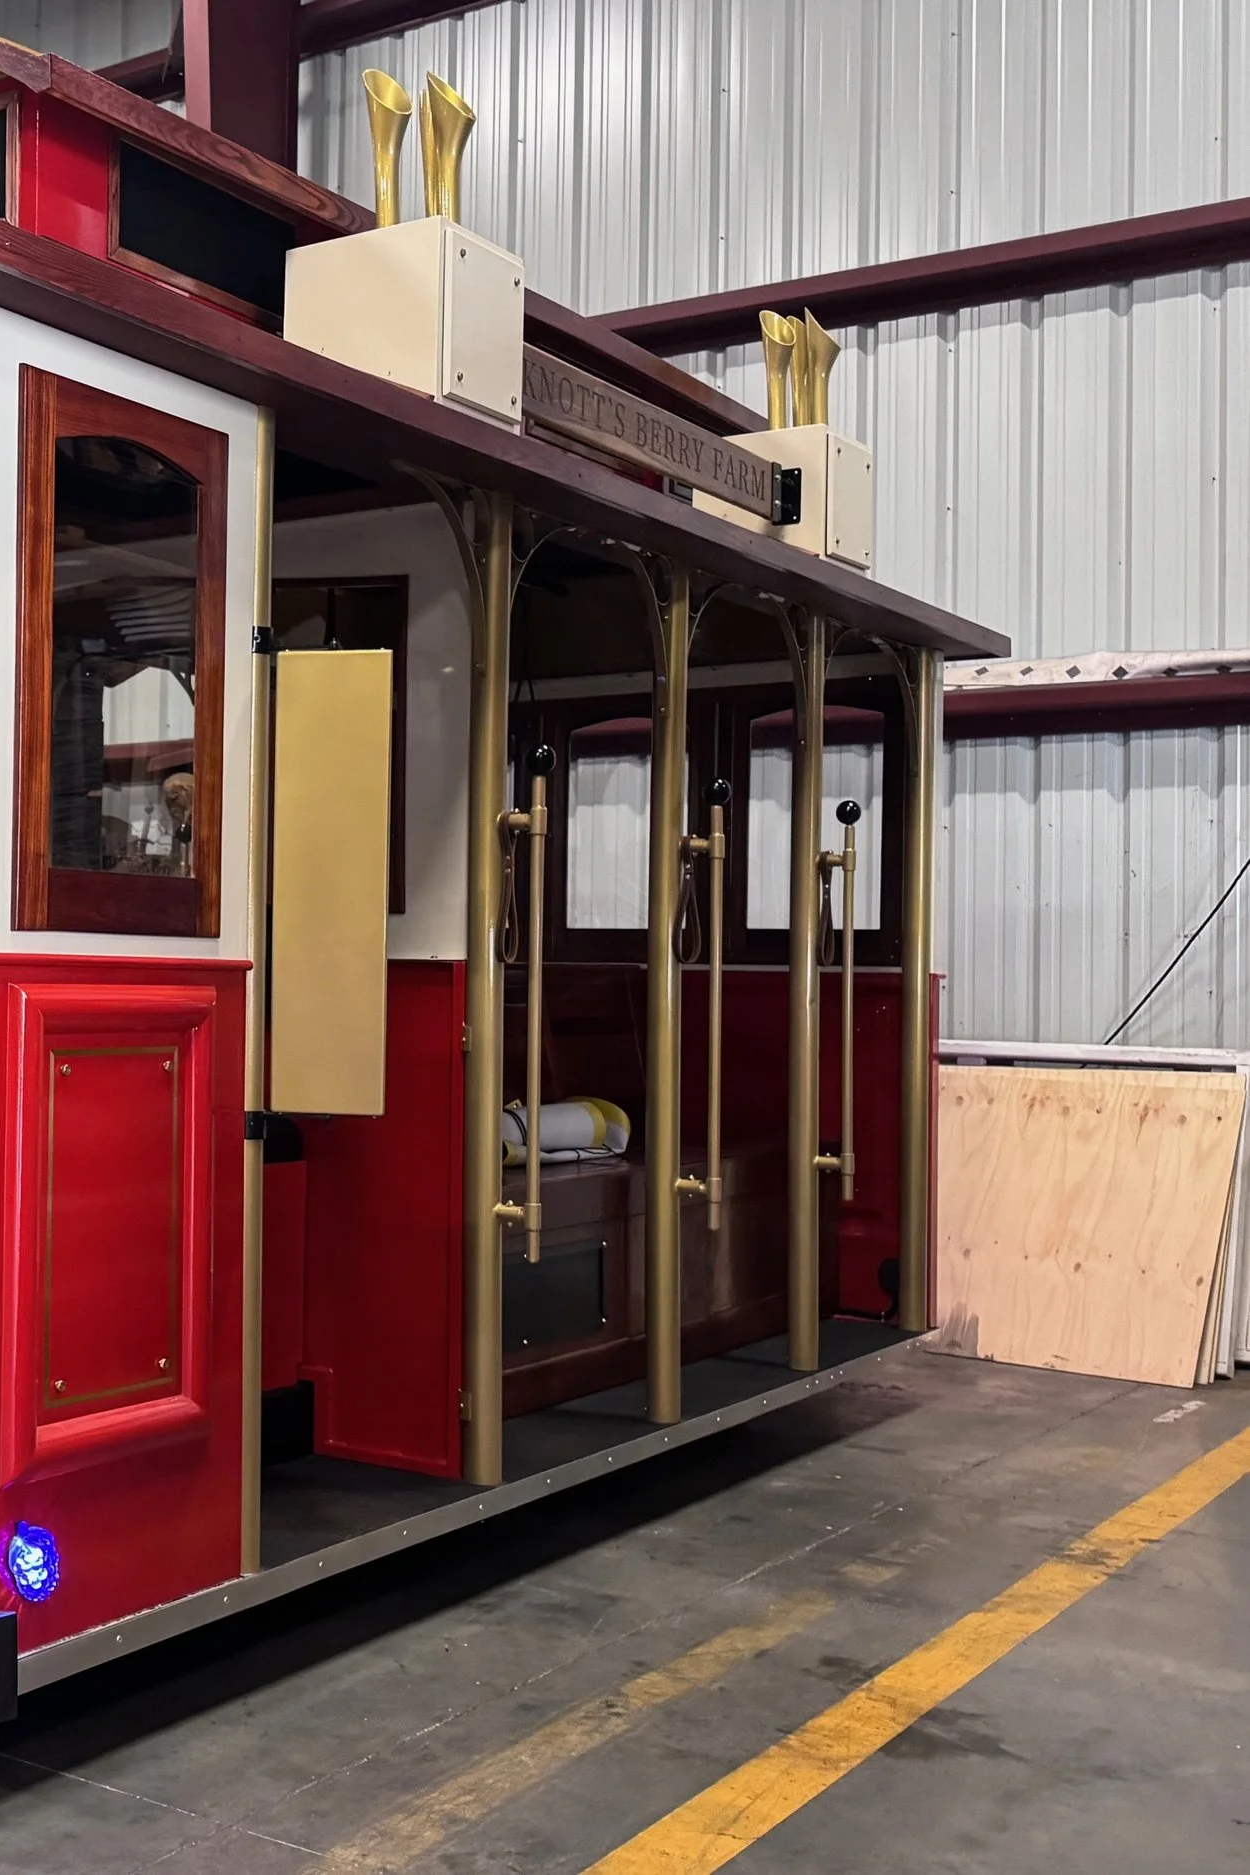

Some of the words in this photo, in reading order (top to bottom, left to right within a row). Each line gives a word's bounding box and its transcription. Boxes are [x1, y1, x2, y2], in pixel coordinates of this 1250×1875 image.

[522, 357, 626, 439] KNOTT'S
[636, 411, 705, 474] BERRY
[712, 447, 767, 501] FARM
